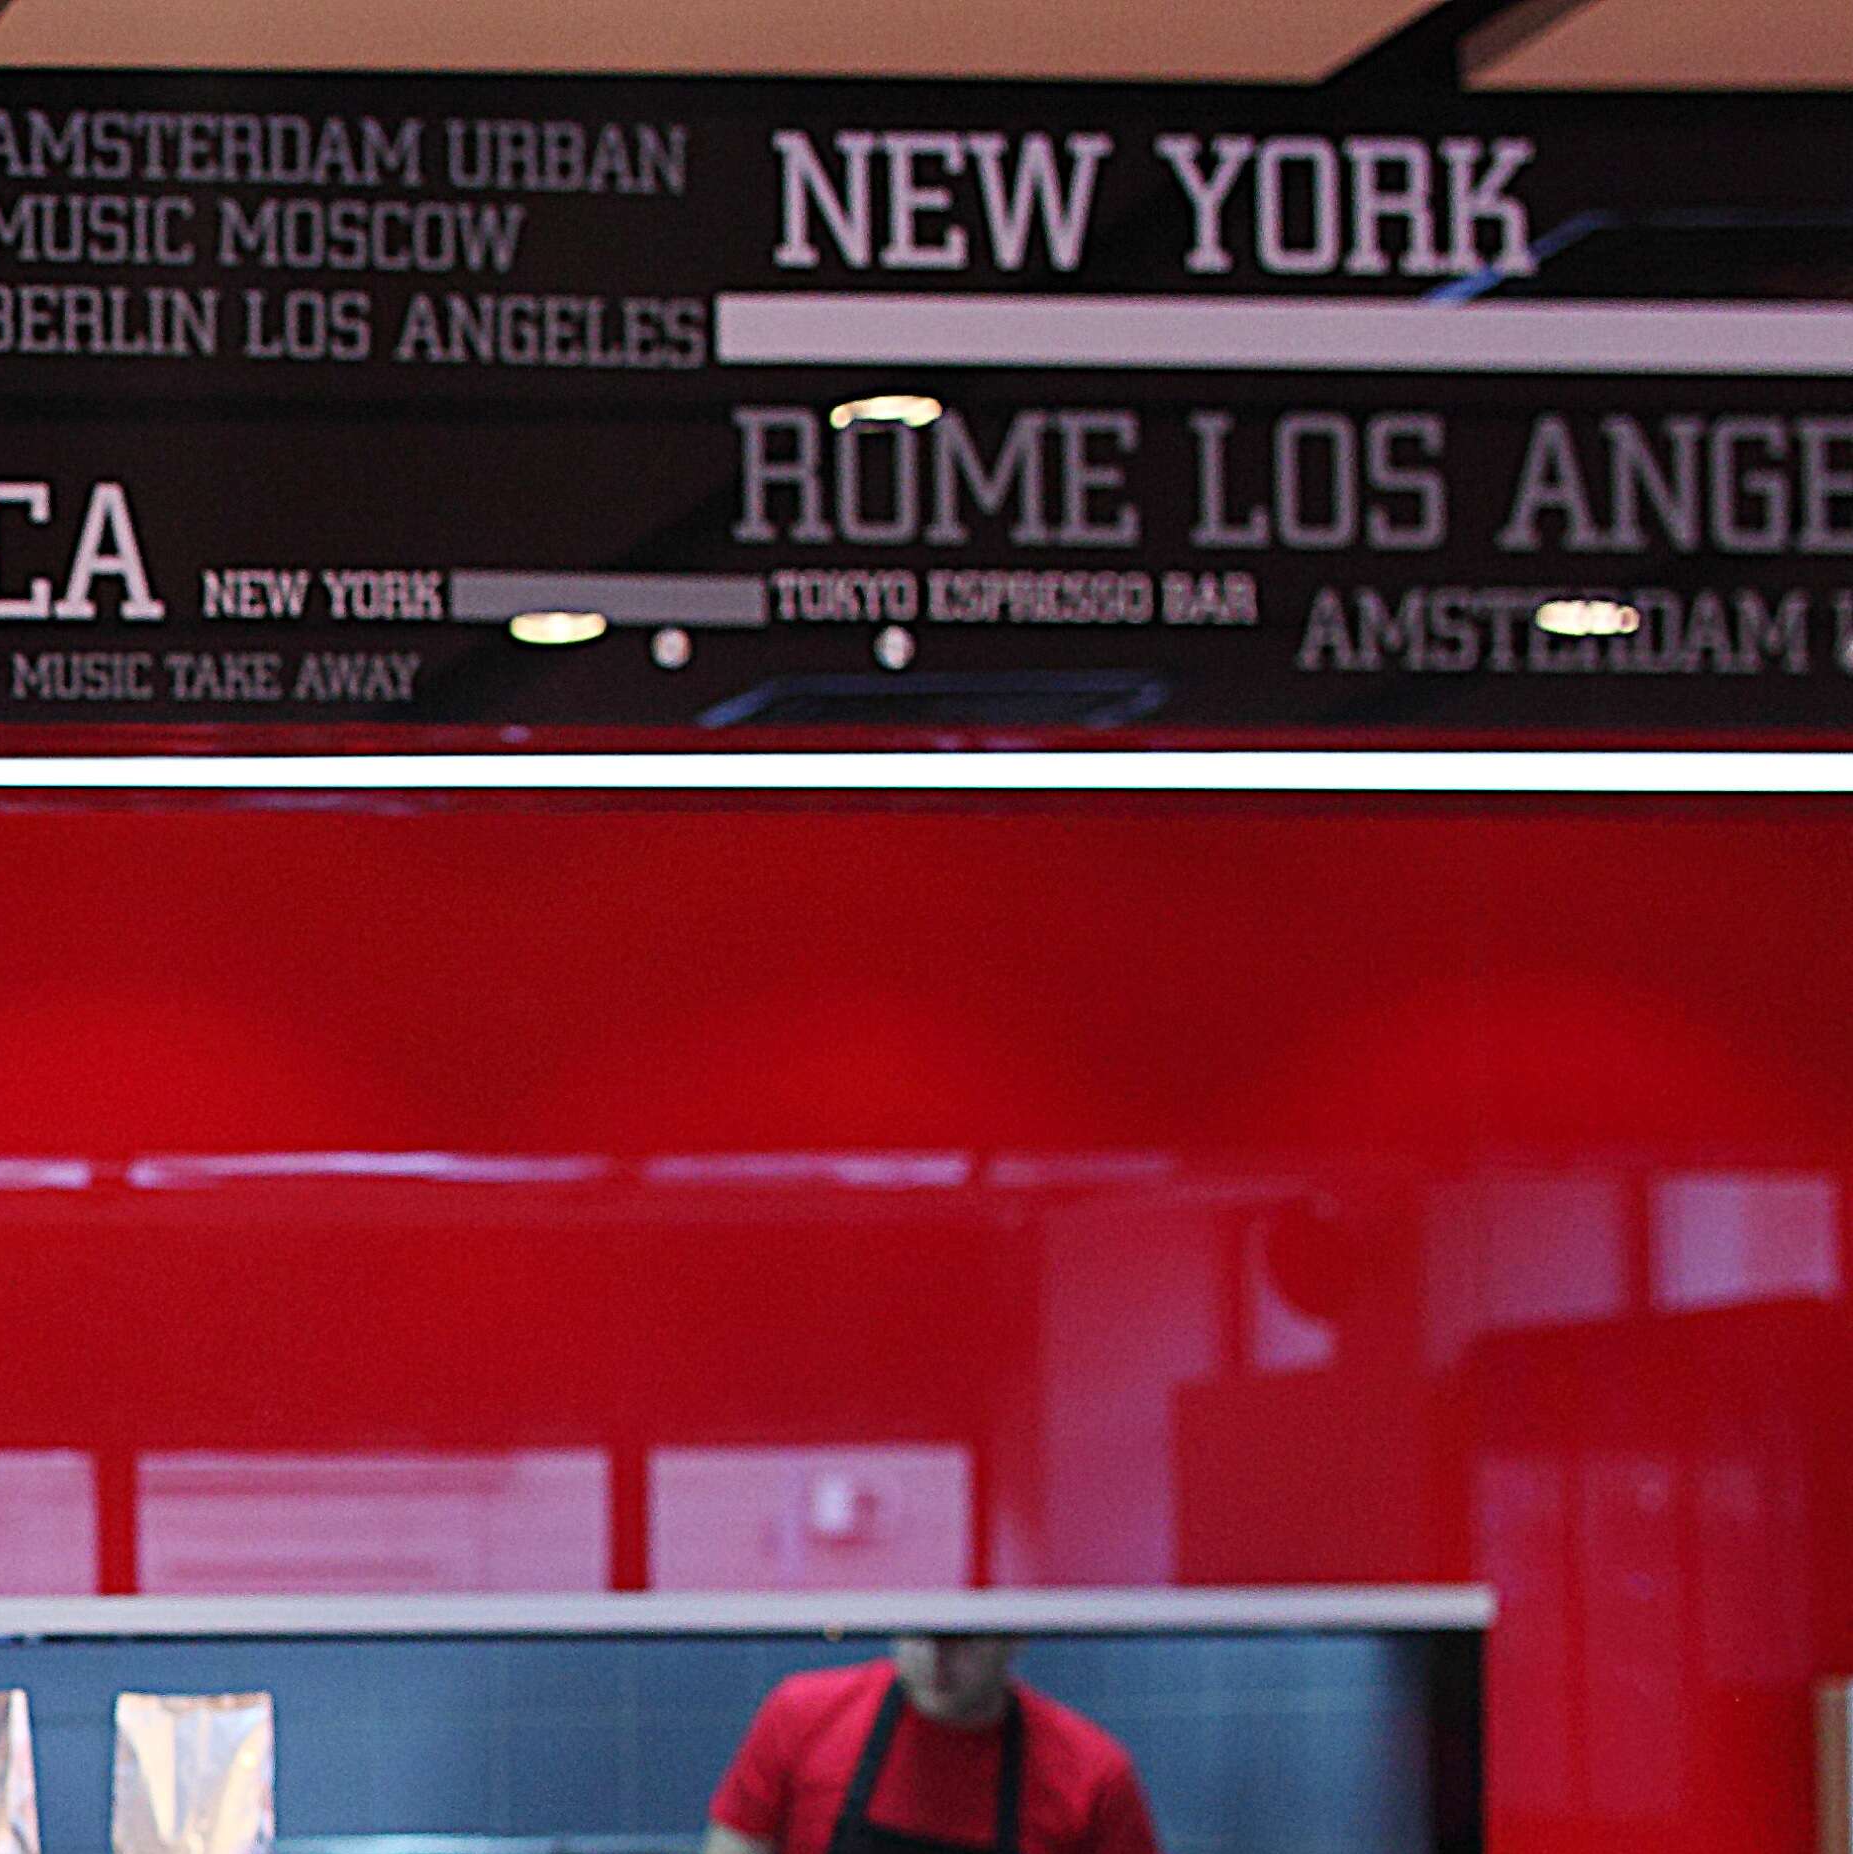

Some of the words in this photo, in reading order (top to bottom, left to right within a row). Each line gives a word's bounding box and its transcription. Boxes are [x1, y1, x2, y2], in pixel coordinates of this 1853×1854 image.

[446, 119, 687, 192] URBAN
[219, 203, 526, 275] MOSCOW
[772, 128, 1111, 271] NEW
[1155, 135, 1536, 279] YORK
[246, 289, 369, 360] LOS
[395, 294, 705, 368] ANGELES
[732, 406, 1139, 549] ROME
[1191, 410, 1444, 549] LOS
[203, 569, 307, 620] NEW
[322, 571, 445, 620] YORK
[770, 571, 915, 623] TOKYO
[929, 572, 1152, 624] ESPRESSO
[1160, 573, 1259, 624] BAR
[1297, 590, 1810, 675] AMSTERDAM
[13, 654, 152, 699] MUSIC
[165, 654, 283, 700] TAKE
[296, 655, 421, 701] AWAY
